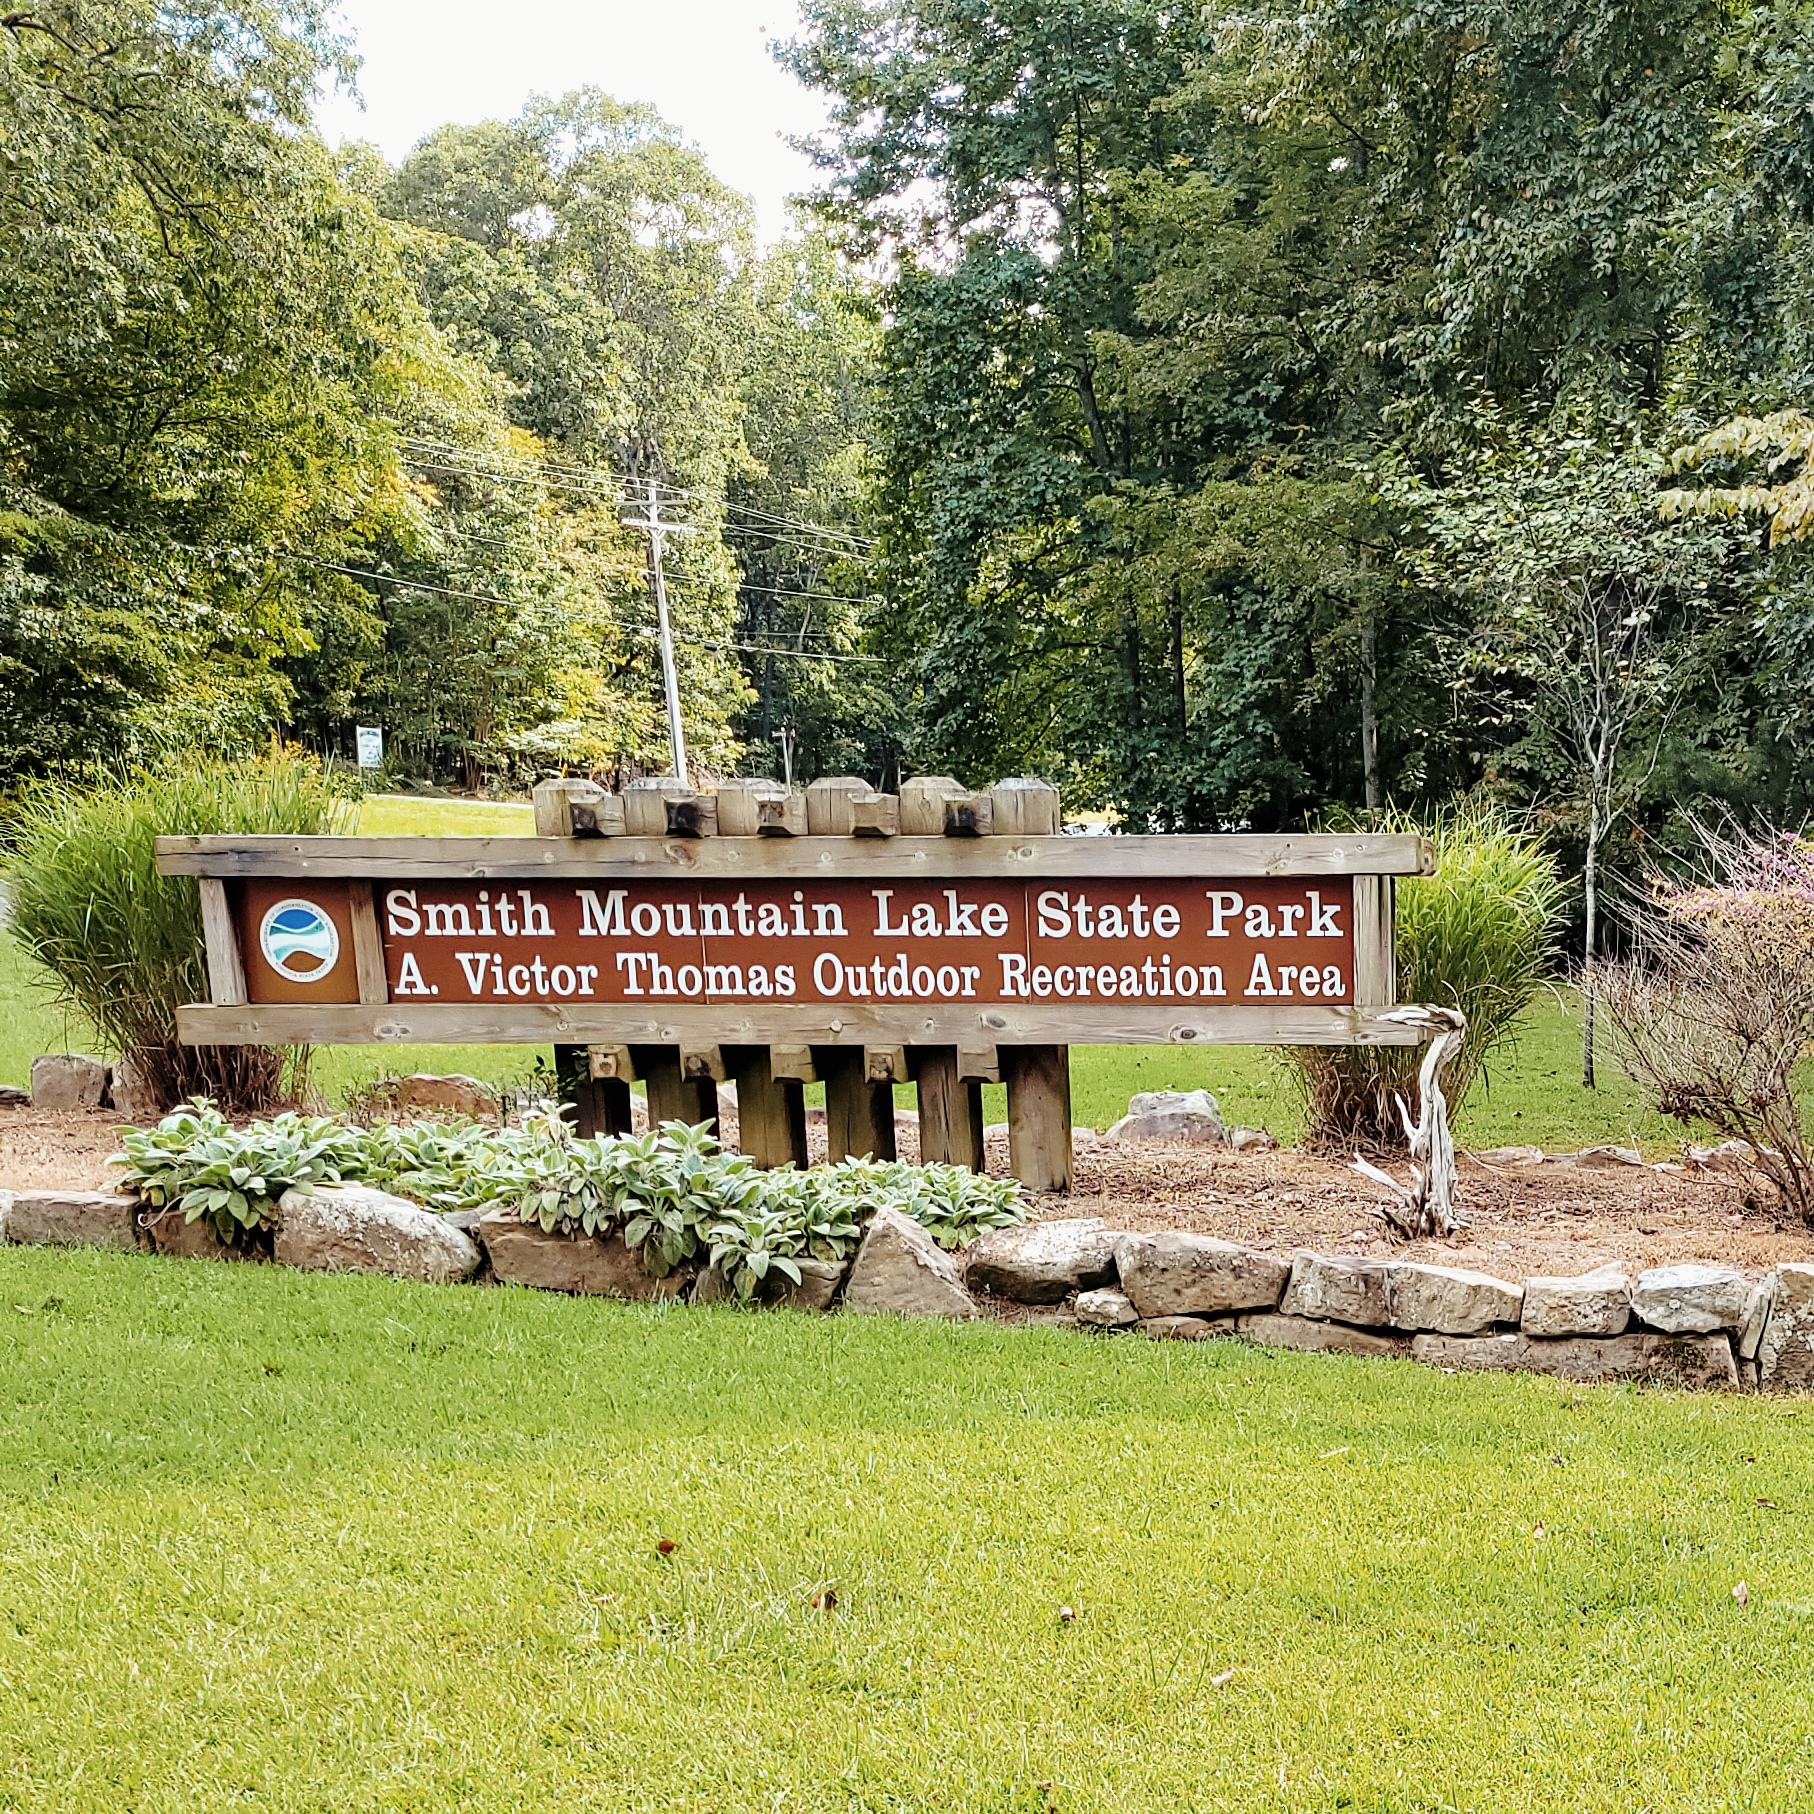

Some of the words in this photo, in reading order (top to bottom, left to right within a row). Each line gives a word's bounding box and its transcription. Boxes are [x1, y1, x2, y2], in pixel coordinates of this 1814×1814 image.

[386, 889, 556, 937] Smith
[576, 890, 849, 937] Mountain
[871, 889, 1009, 937] Lake
[1037, 890, 1181, 939] State
[1206, 890, 1344, 938] Park
[394, 952, 439, 995] A.
[454, 952, 599, 996] Victor
[615, 952, 797, 997] Thomas
[813, 952, 981, 997] Outdoor
[998, 953, 1227, 997] Recreation
[1243, 953, 1346, 997] Area
